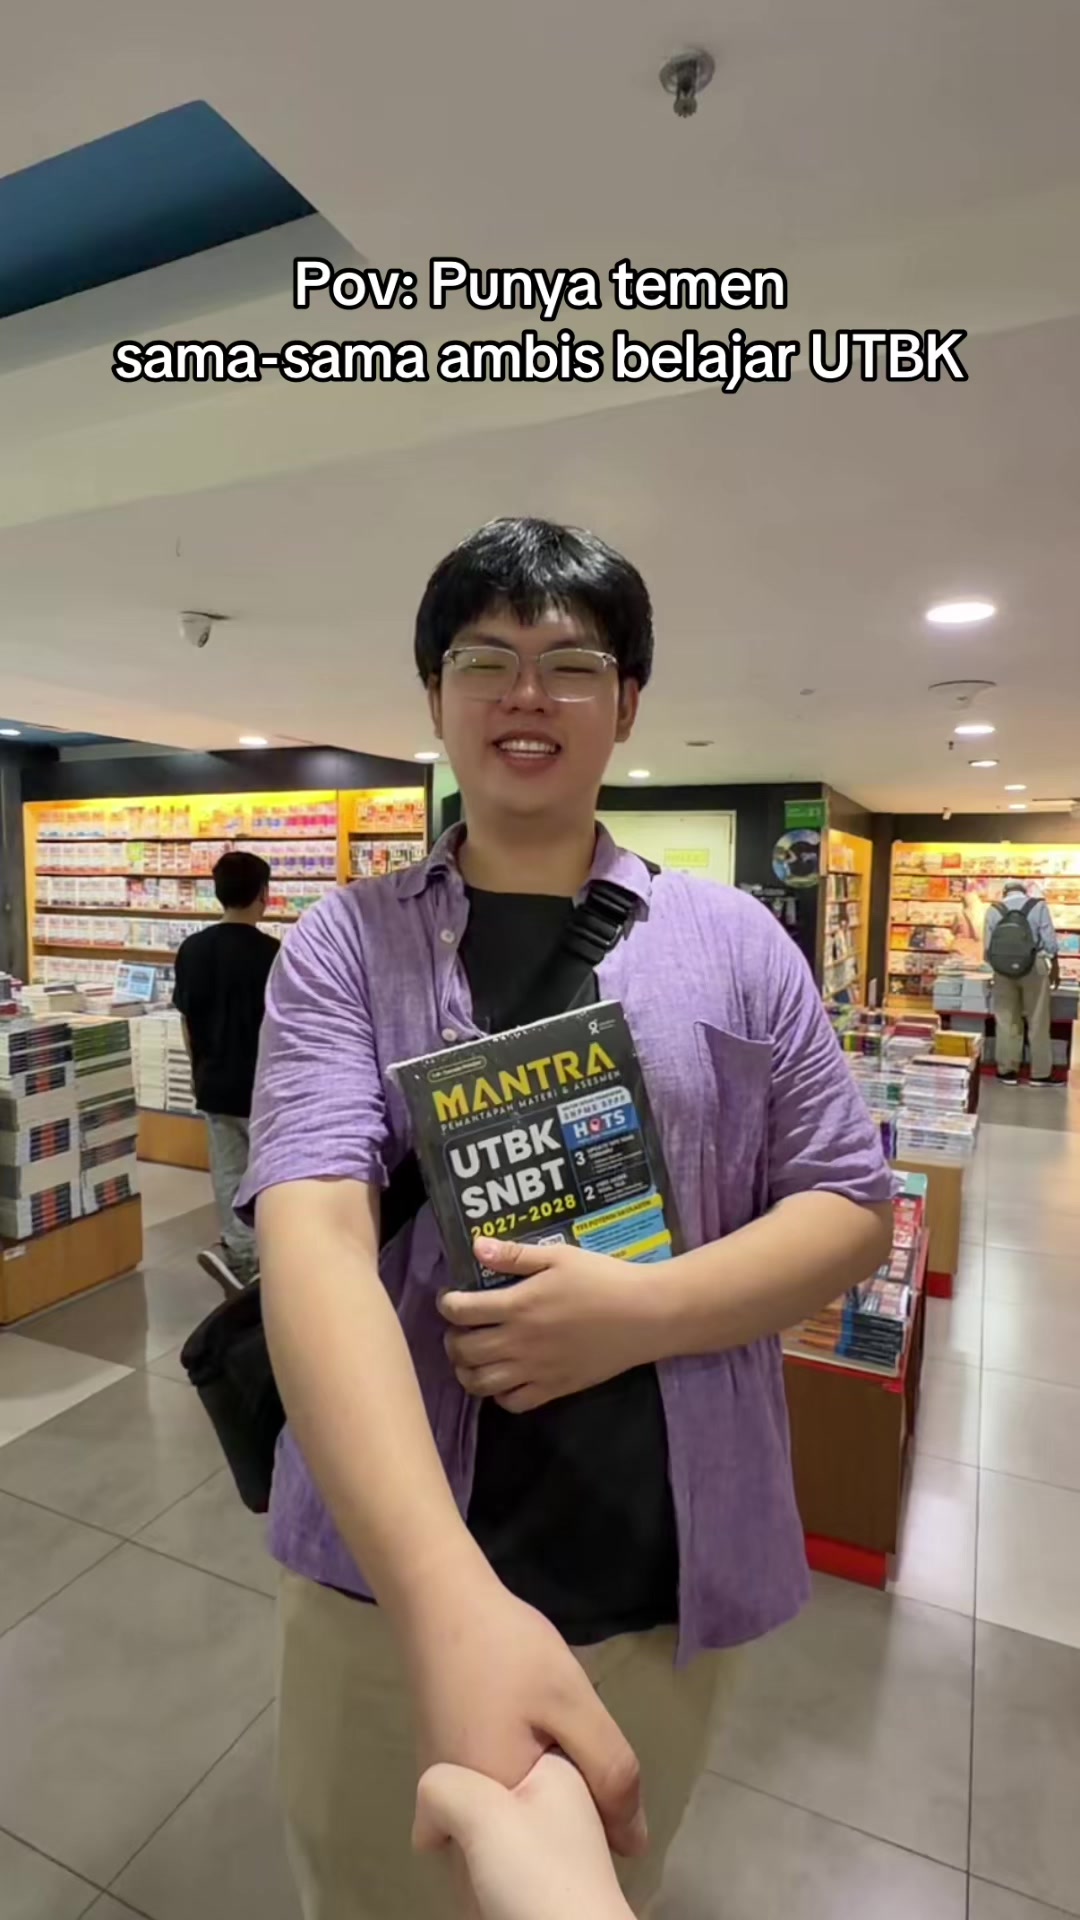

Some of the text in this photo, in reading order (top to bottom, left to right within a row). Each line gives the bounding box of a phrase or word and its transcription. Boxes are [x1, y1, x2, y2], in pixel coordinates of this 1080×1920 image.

[432, 1042, 616, 1122] MANTRA
[441, 1104, 515, 1132] PEMANTAPAN
[518, 1090, 557, 1109] MATERI
[573, 1070, 621, 1091] ASESMEN
[450, 1118, 561, 1179] UTBK
[575, 1151, 586, 1166] 3
[461, 1157, 565, 1220] SNBT
[470, 1194, 577, 1239] 2027-2028
[584, 1185, 596, 1201] 2
